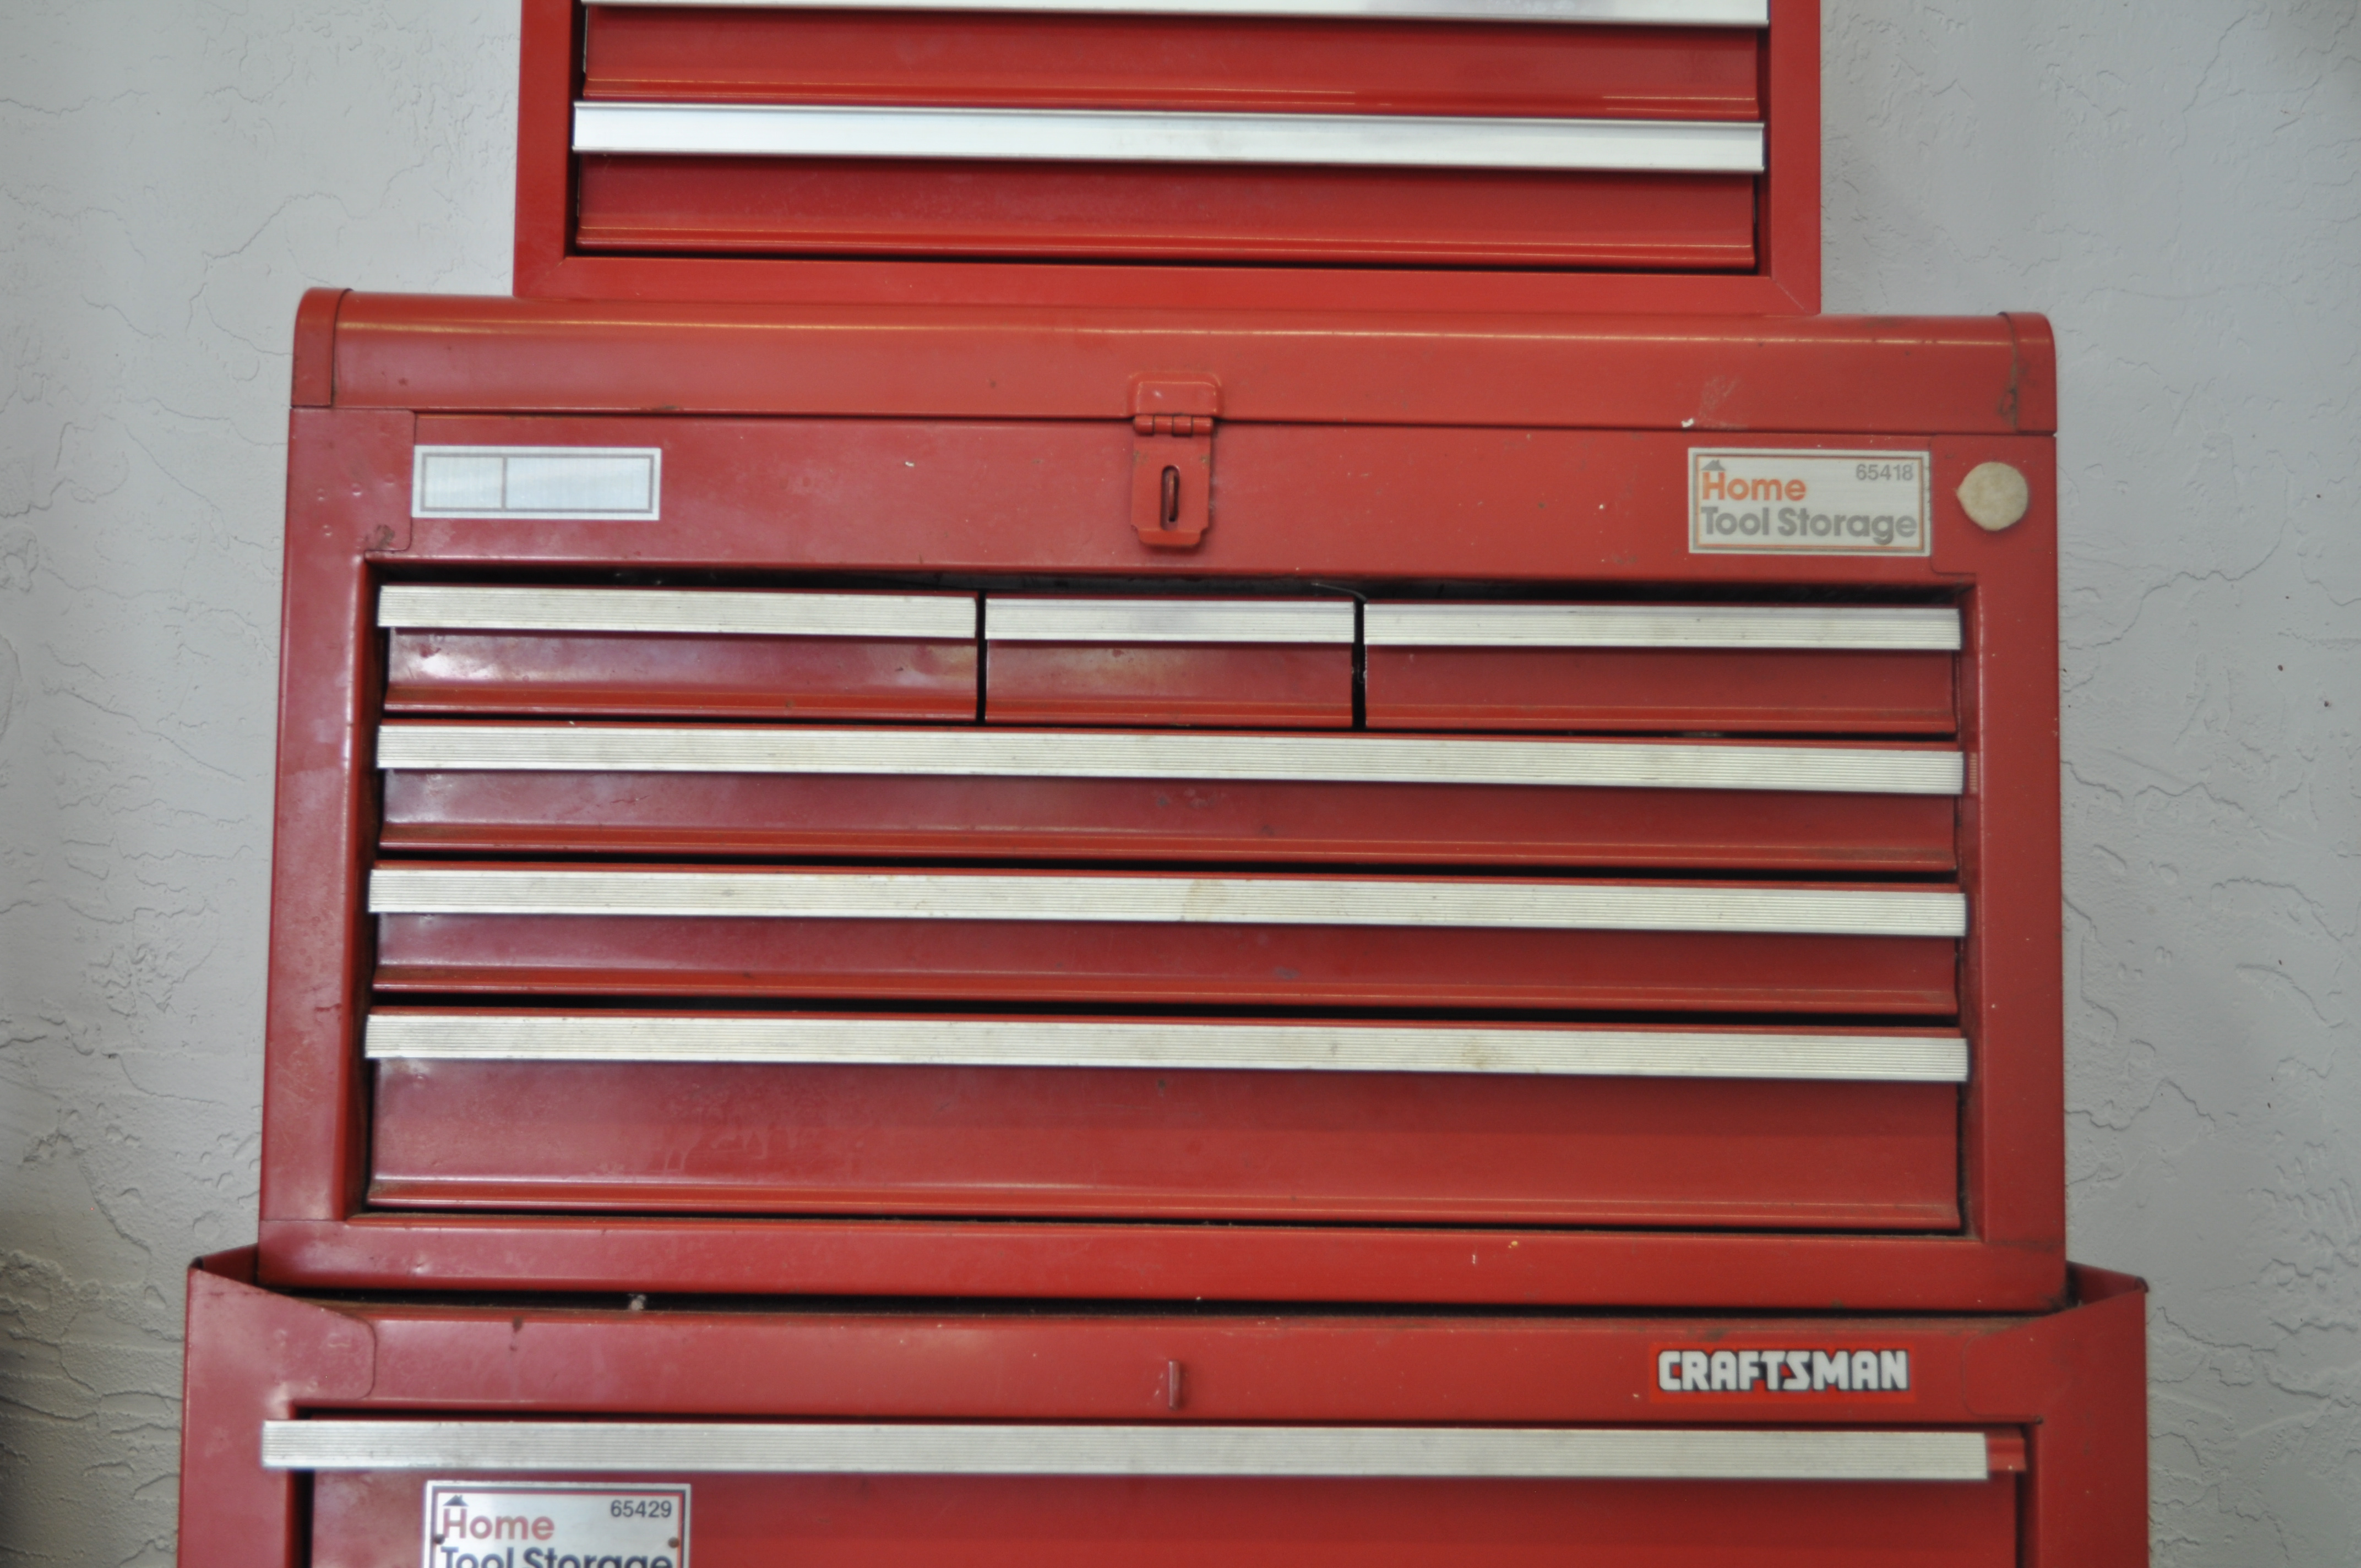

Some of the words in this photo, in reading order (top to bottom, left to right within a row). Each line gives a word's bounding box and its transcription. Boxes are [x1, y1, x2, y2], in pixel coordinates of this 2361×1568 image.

[1702, 471, 1807, 500] Home
[1856, 464, 1914, 481] 65418
[1700, 506, 1770, 536] Tool
[1777, 508, 1918, 546] Storage
[1658, 1349, 1910, 1391] CRAFTSMAN
[610, 1500, 672, 1518] 65429
[443, 1508, 554, 1541] Home
[440, 1546, 514, 1568] Tool
